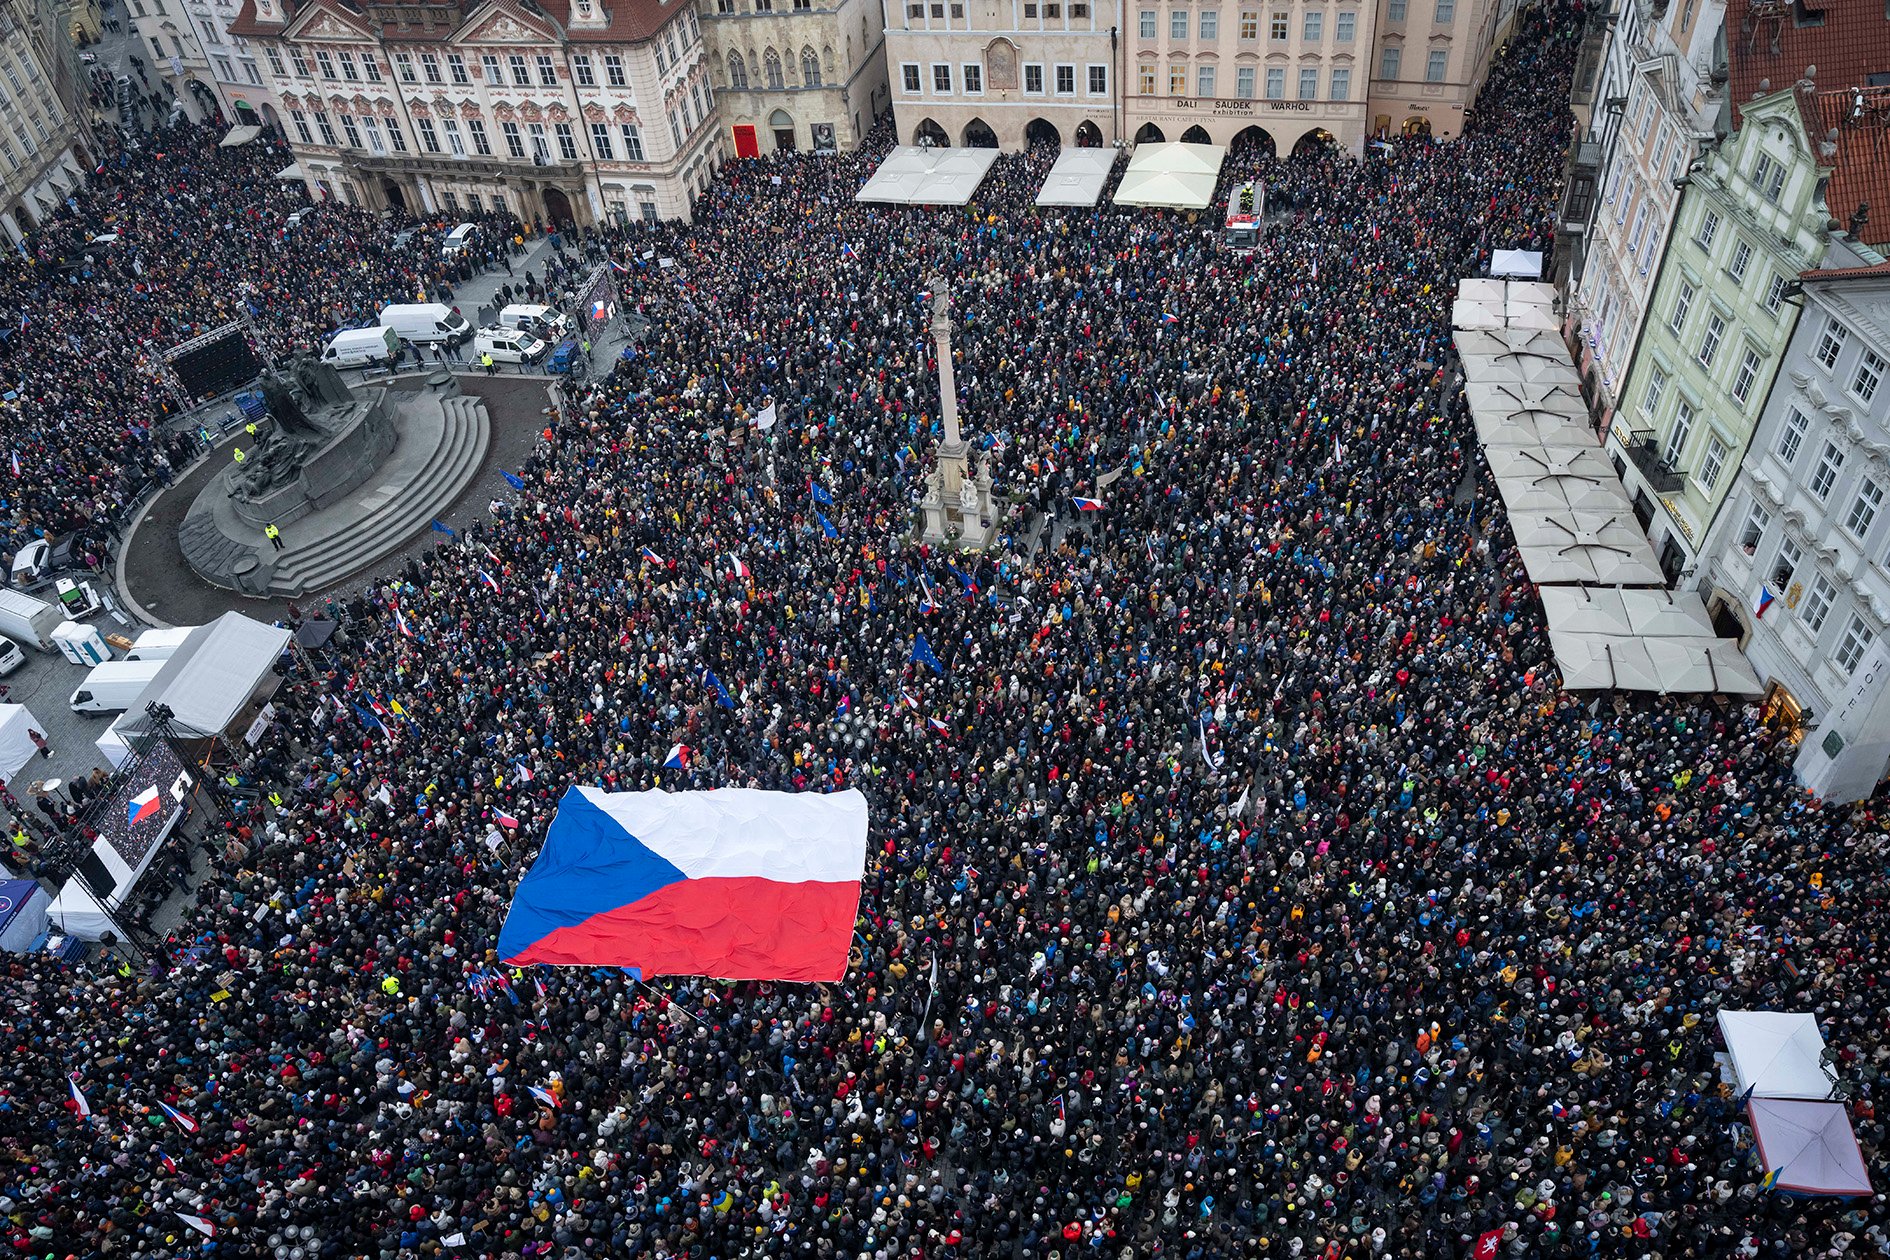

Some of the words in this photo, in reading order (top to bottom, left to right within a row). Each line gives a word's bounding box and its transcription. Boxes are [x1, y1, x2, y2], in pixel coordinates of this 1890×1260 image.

[1177, 100, 1197, 108] DALI
[1215, 101, 1250, 109] SAUDEK
[1270, 102, 1310, 111] WARHOL
[1840, 660, 1882, 721] HOTEL
